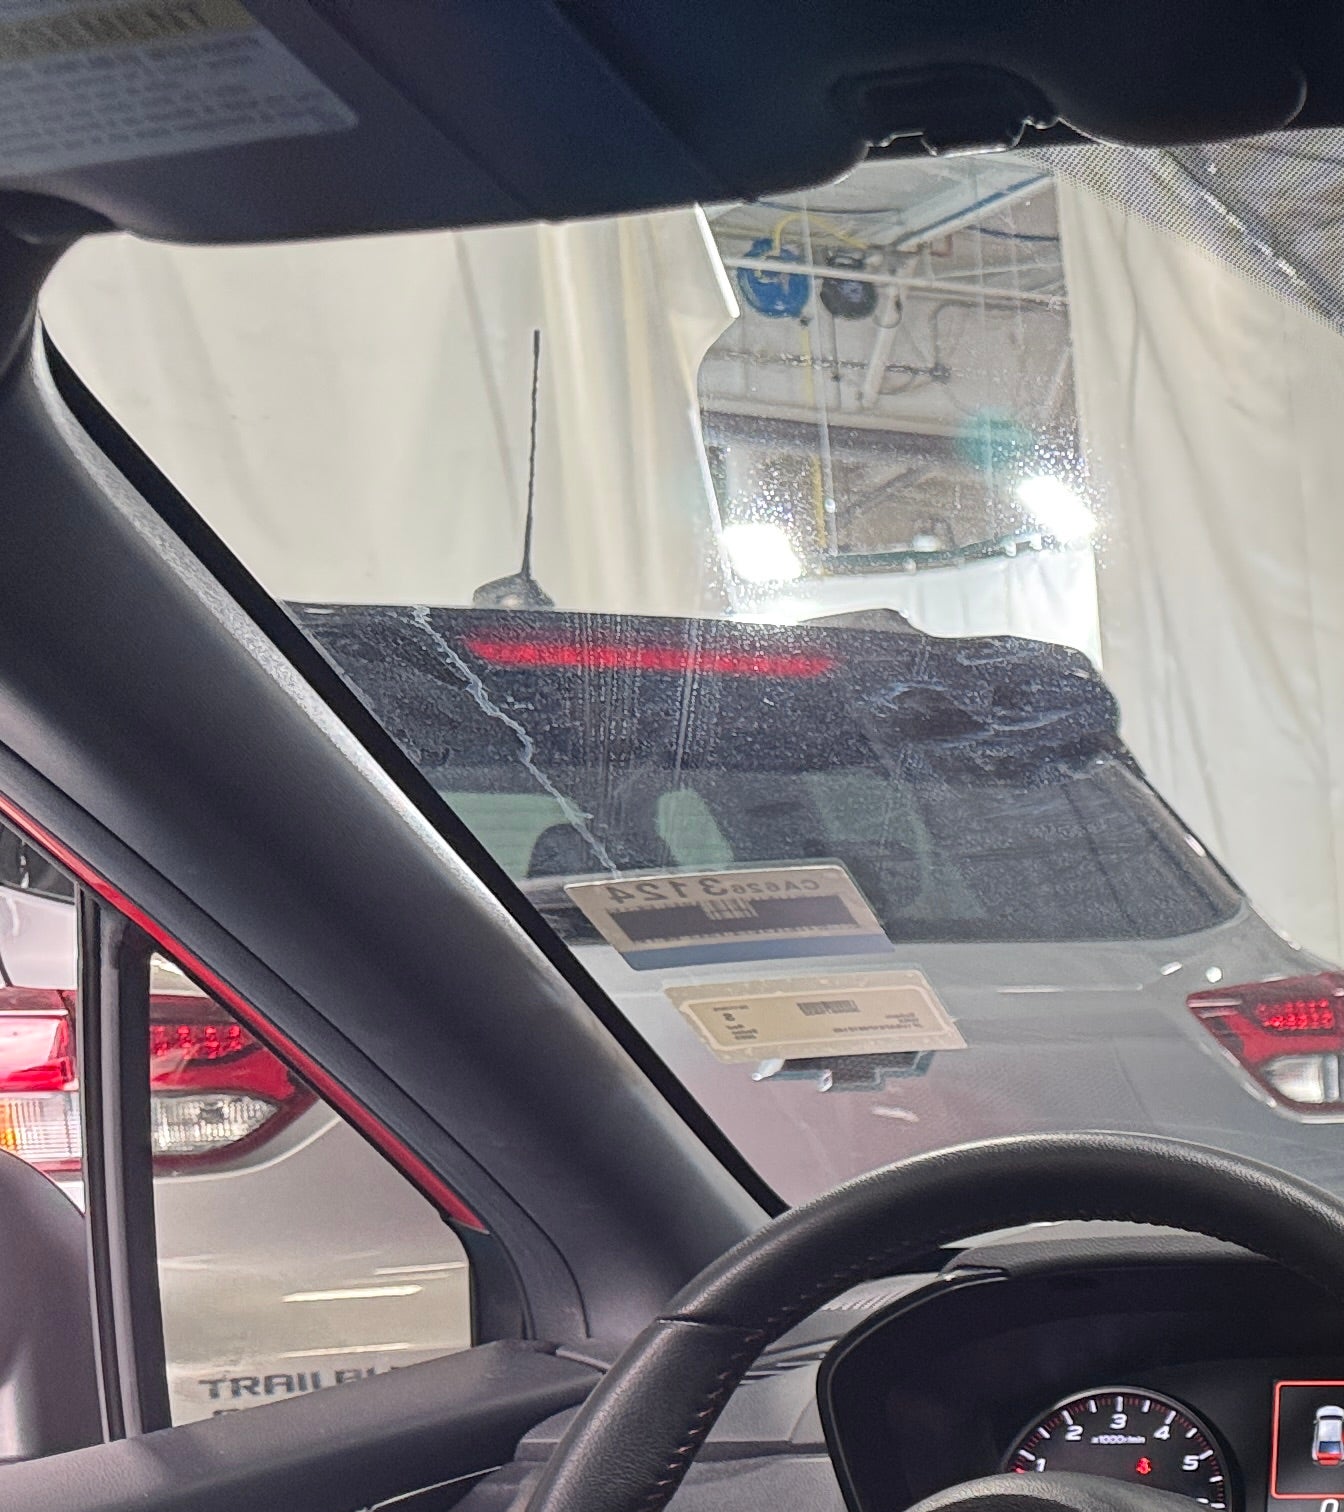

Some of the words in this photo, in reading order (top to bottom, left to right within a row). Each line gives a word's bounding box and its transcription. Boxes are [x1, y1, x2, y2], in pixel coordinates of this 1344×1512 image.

[1109, 1413, 1127, 1429] 3
[1065, 1425, 1083, 1441] 2
[1153, 1425, 1170, 1441] 4
[1036, 1458, 1046, 1473] 1
[1182, 1455, 1199, 1471] 5
